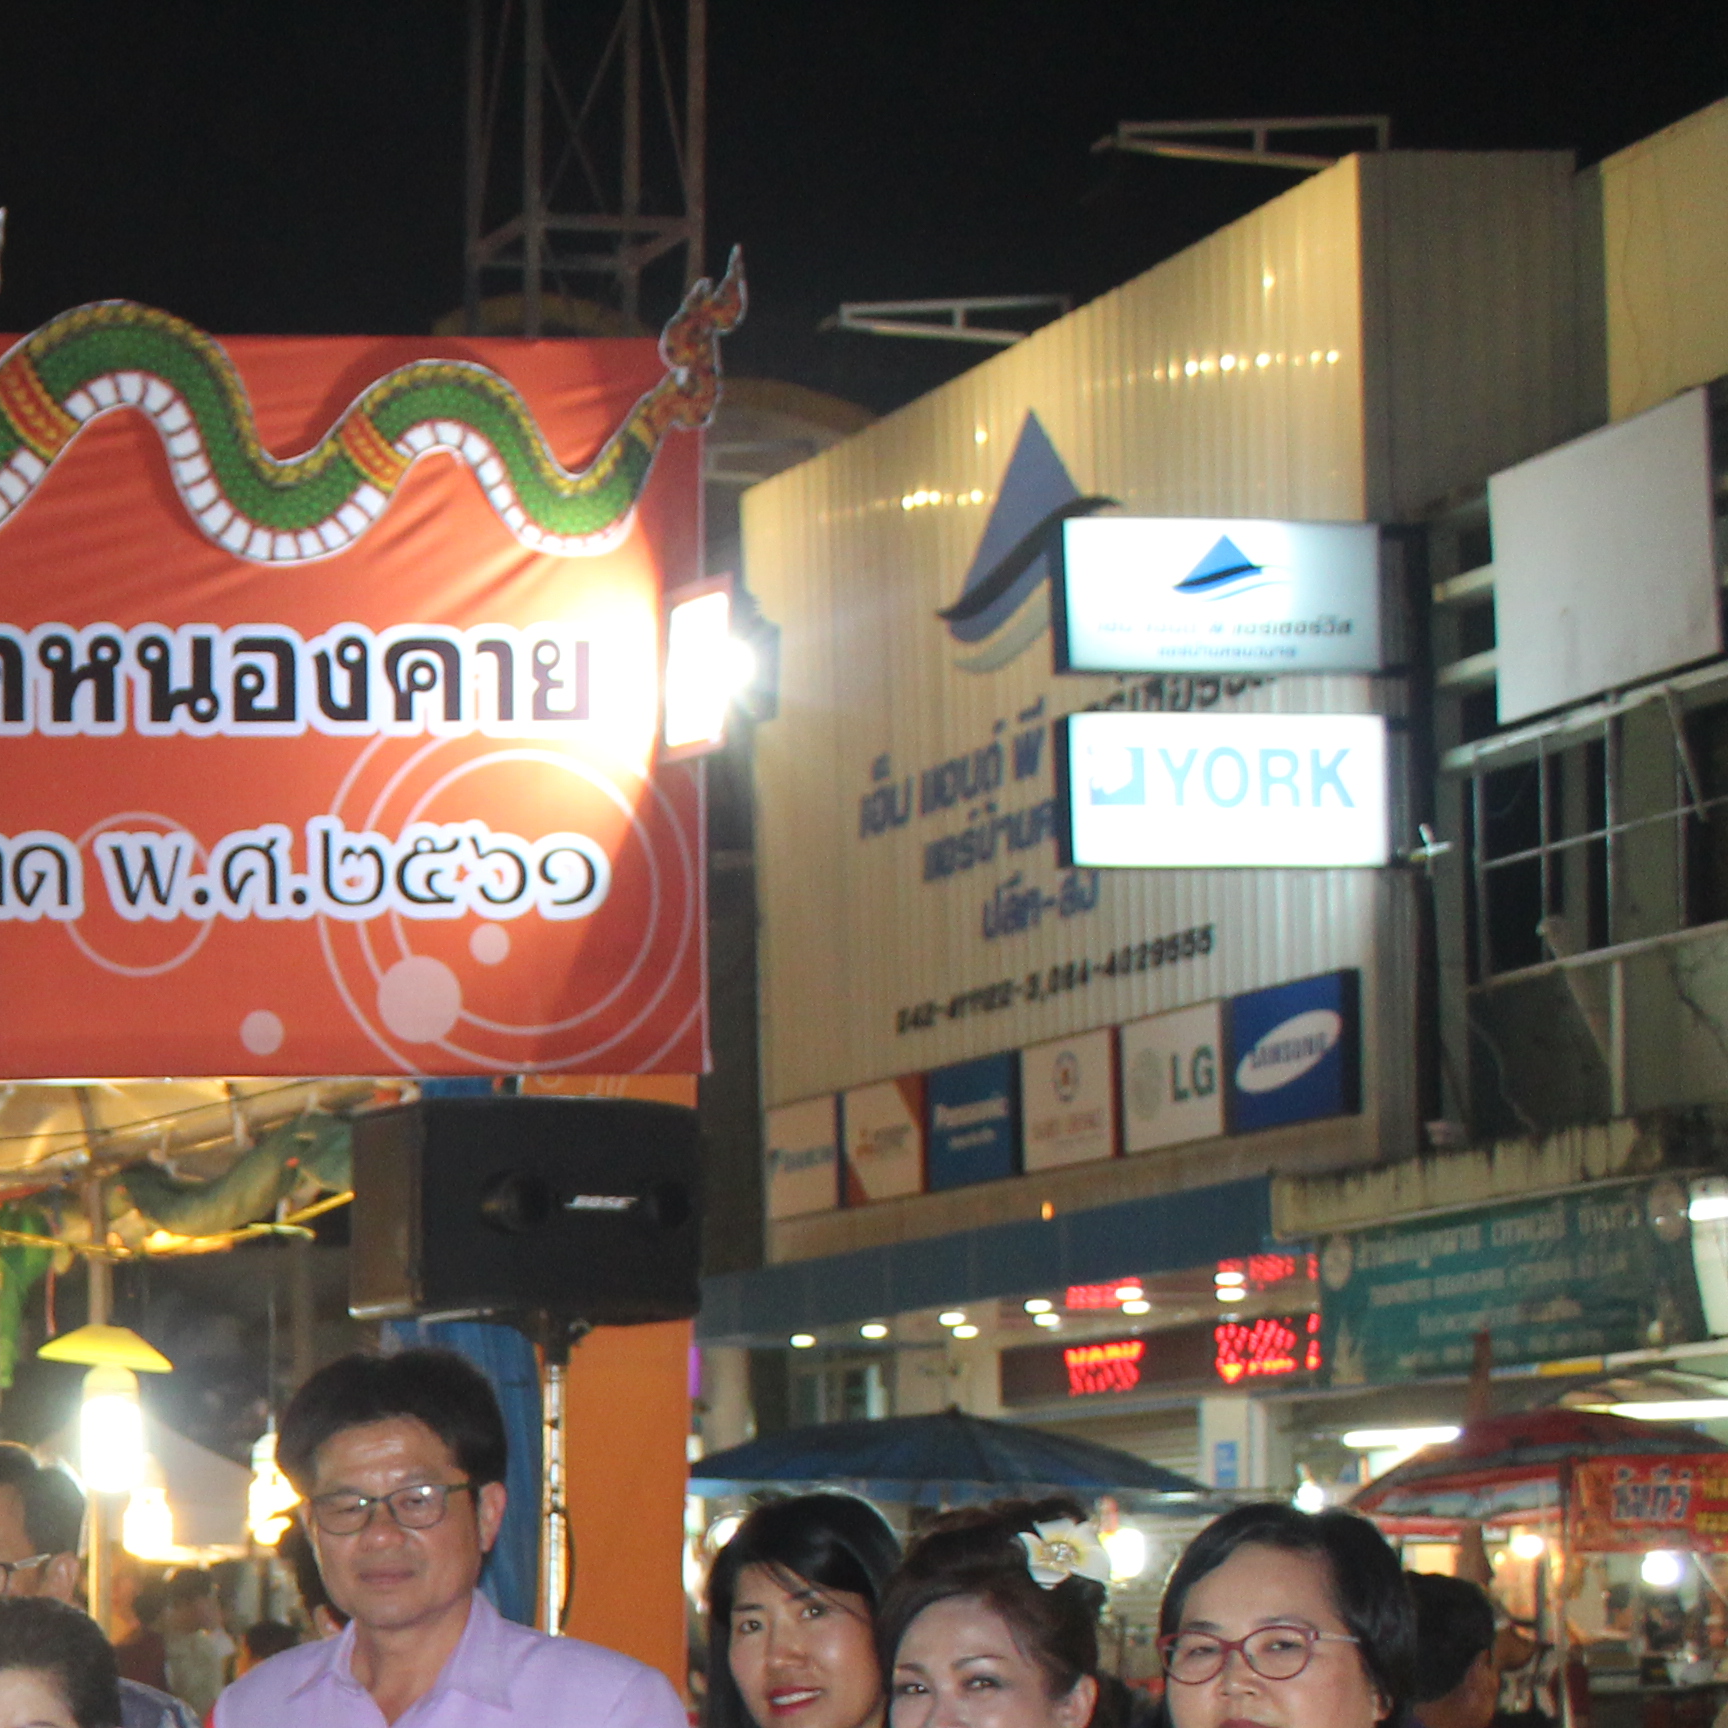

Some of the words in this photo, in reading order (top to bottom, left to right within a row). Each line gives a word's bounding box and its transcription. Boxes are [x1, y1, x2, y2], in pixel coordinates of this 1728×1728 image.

[1157, 746, 1356, 809] YORK
[110, 828, 600, 910] พ.ศ.๒๕๖๑
[1171, 1045, 1216, 1103] LG
